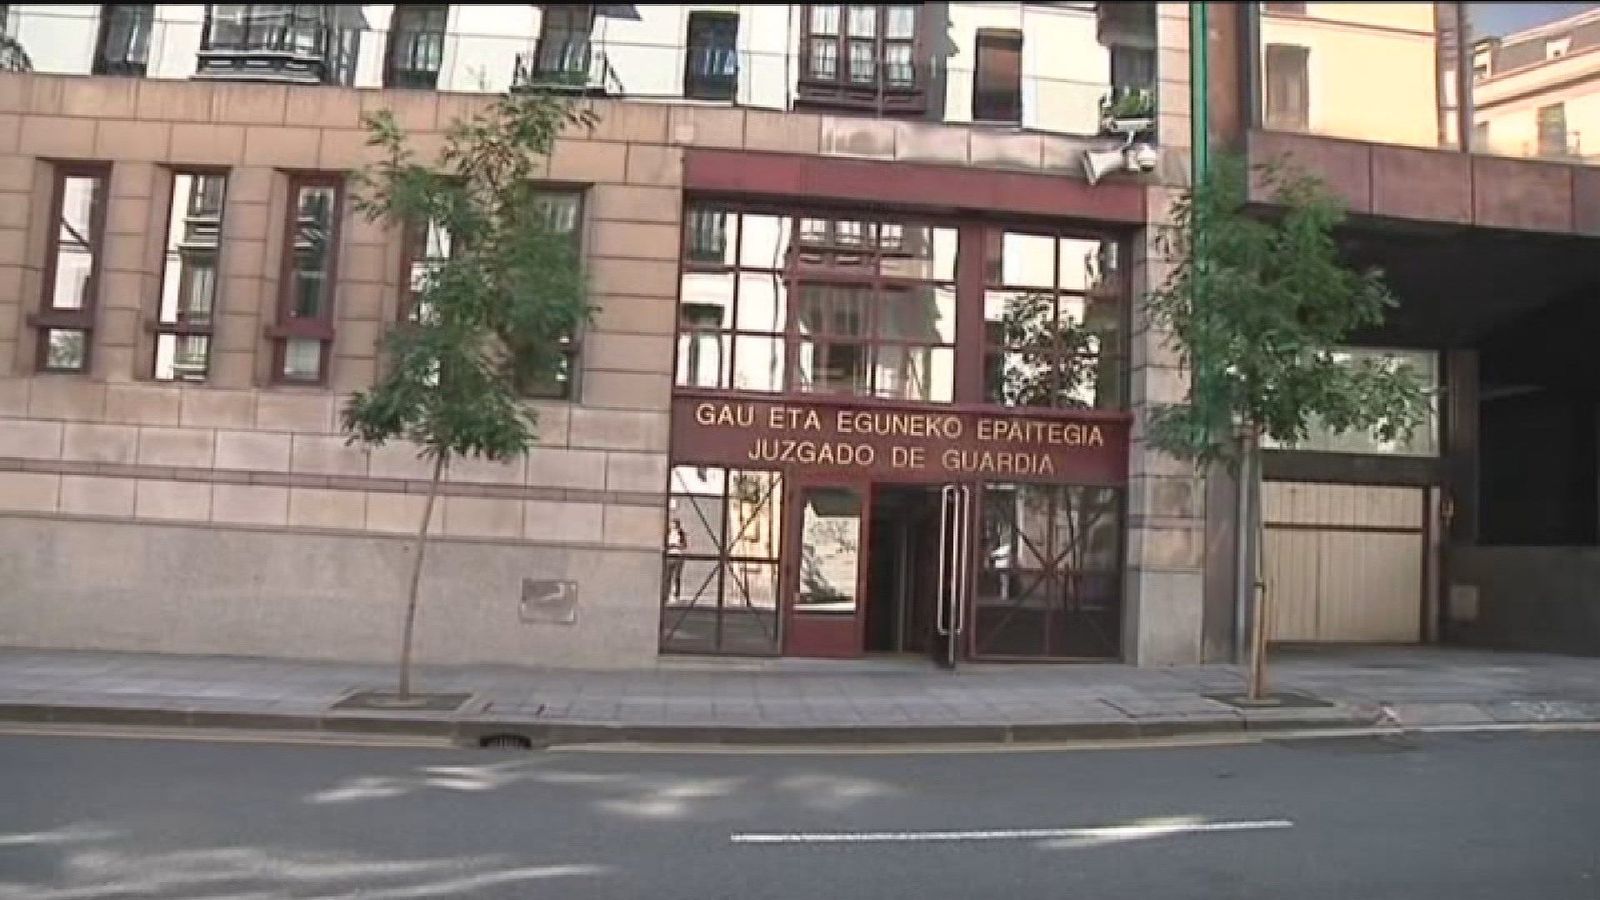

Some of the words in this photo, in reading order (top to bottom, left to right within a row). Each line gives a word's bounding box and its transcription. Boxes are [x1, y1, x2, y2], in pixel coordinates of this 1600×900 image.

[696, 403, 754, 428] GAU
[769, 409, 821, 432] ETA
[837, 411, 963, 439] EGUNEKO
[977, 419, 1104, 447] EPAITEGIA
[748, 438, 875, 465] JUZGADO
[892, 447, 925, 469] DE
[941, 450, 1055, 475] GUARDIA
